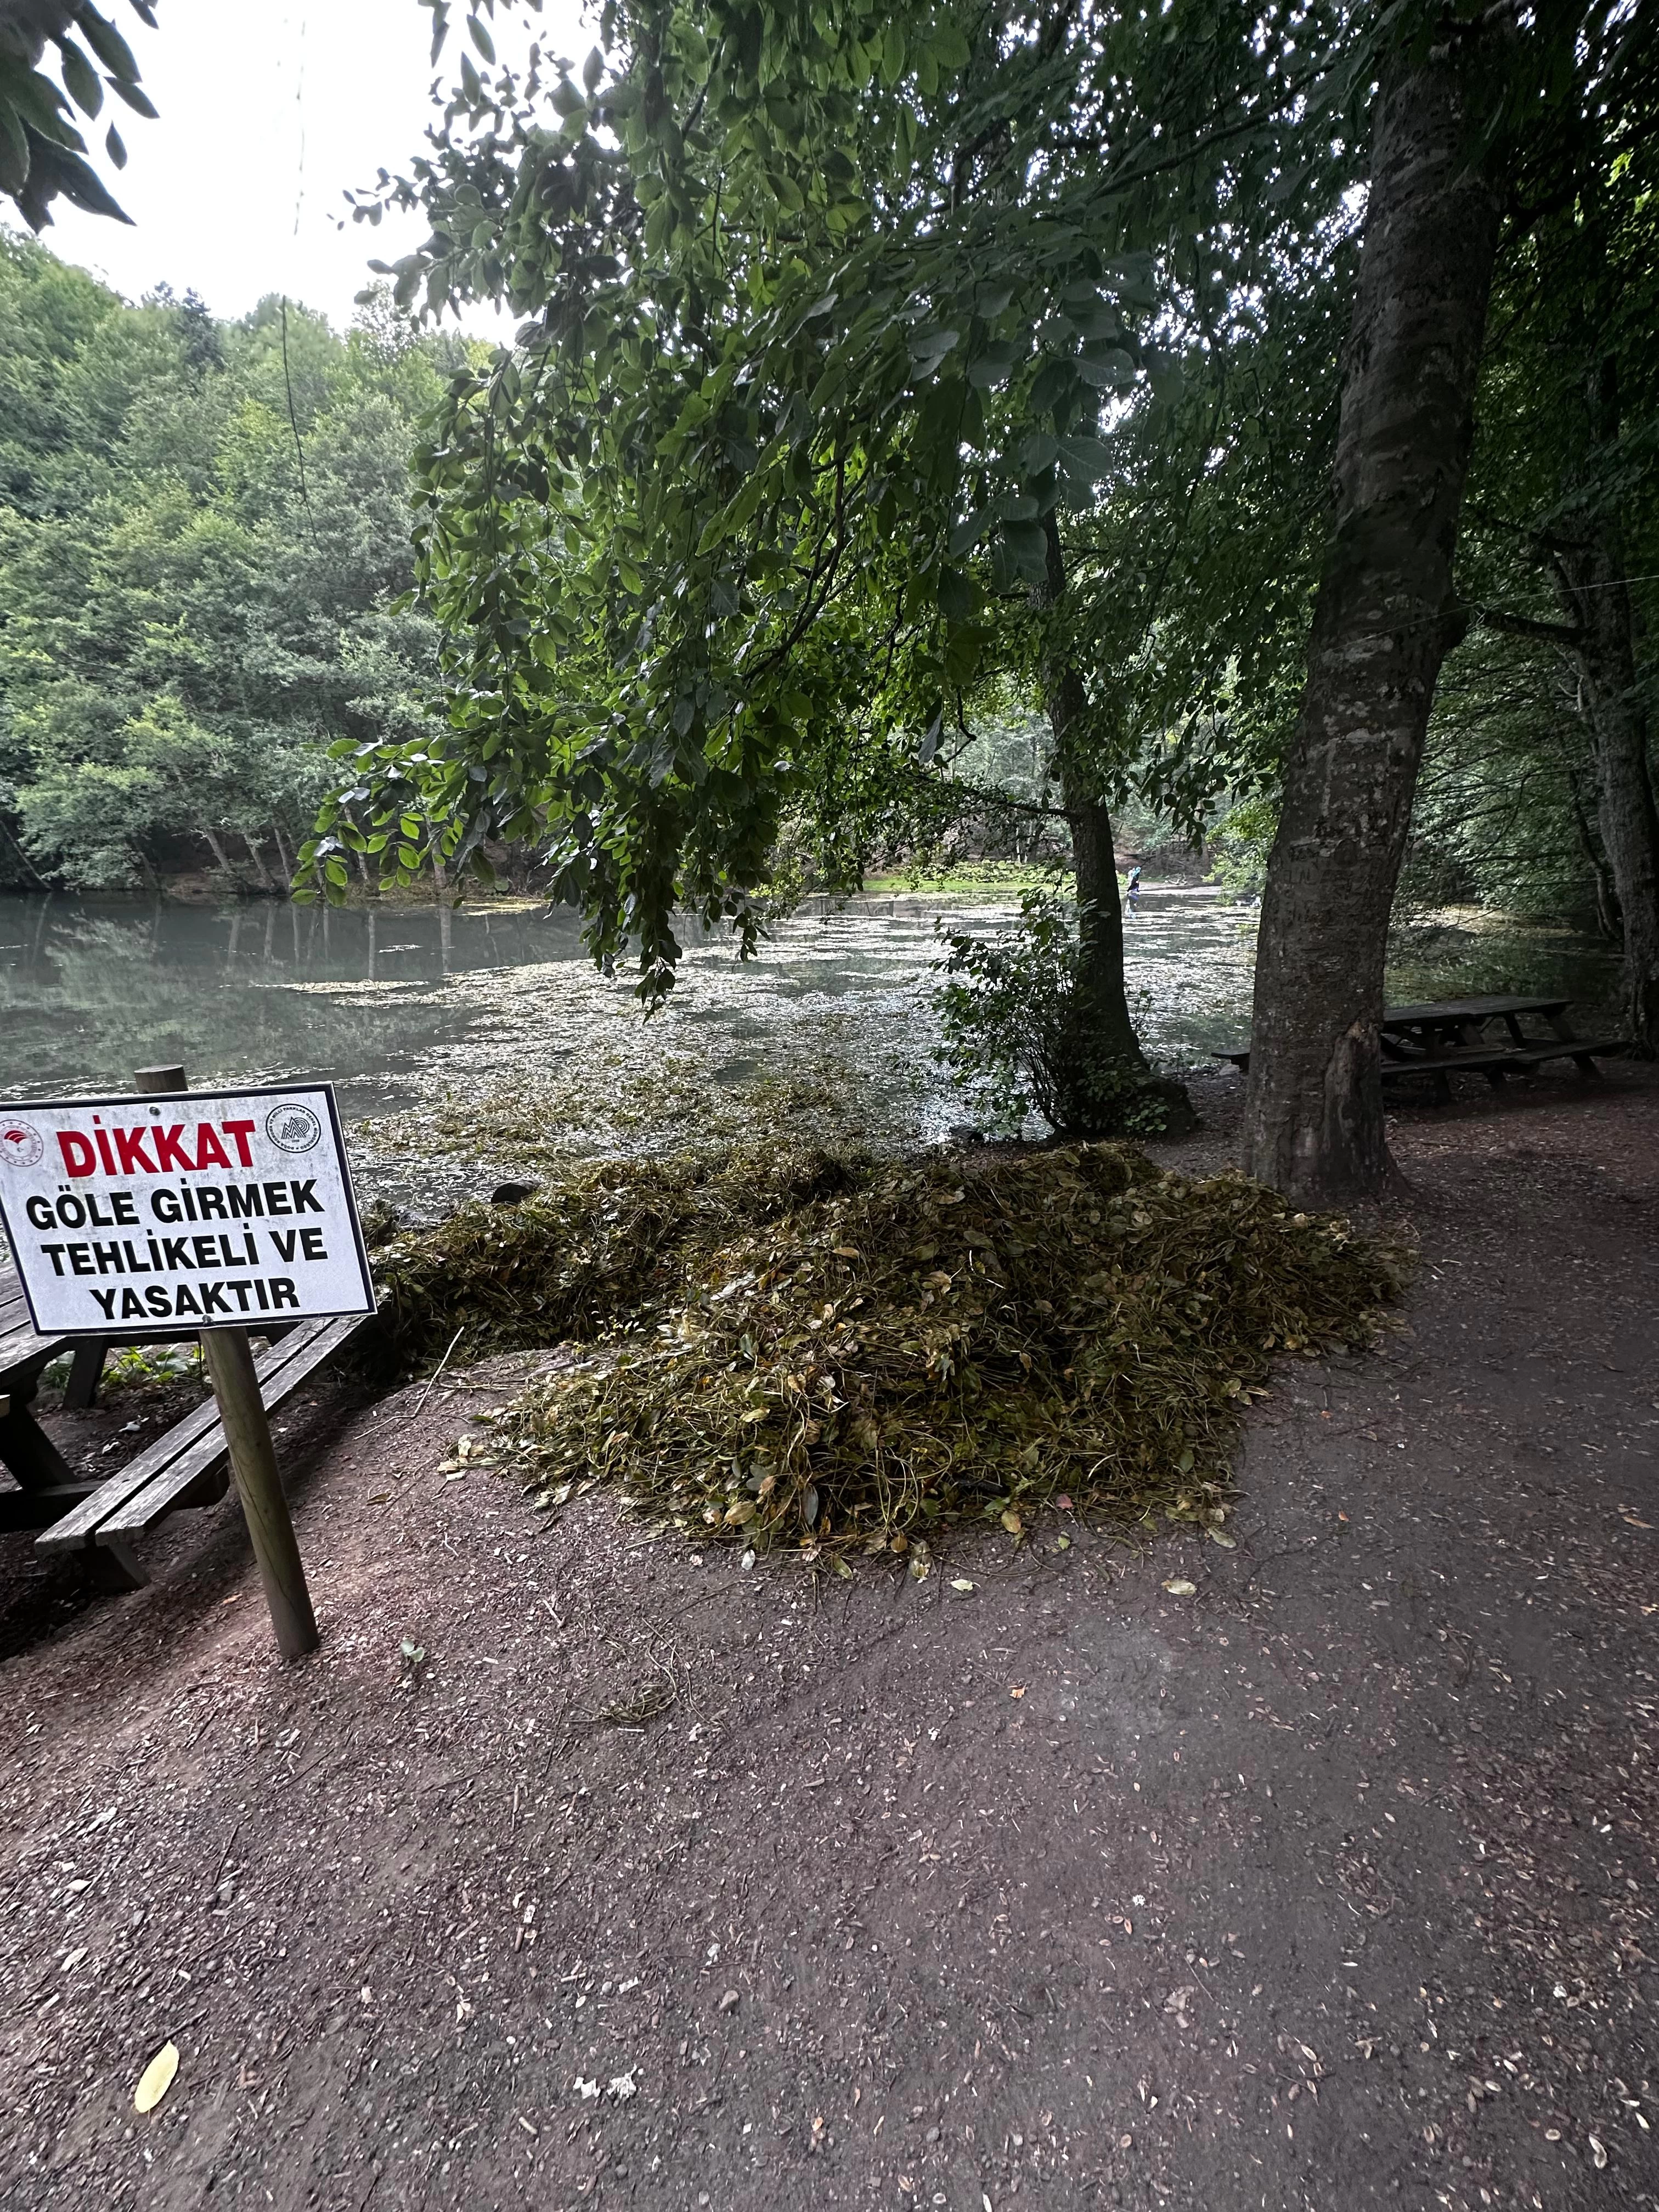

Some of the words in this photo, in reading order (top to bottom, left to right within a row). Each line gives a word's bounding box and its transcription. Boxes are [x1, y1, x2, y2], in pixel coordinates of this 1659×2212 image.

[57, 1115, 255, 1178] DİKKAT
[26, 1184, 140, 1230] GÖLE
[150, 1178, 325, 1223] GİRMEK
[40, 1222, 259, 1276] TEHLİKELİ
[268, 1227, 328, 1262] VE
[89, 1278, 301, 1320] YASAKTIR
